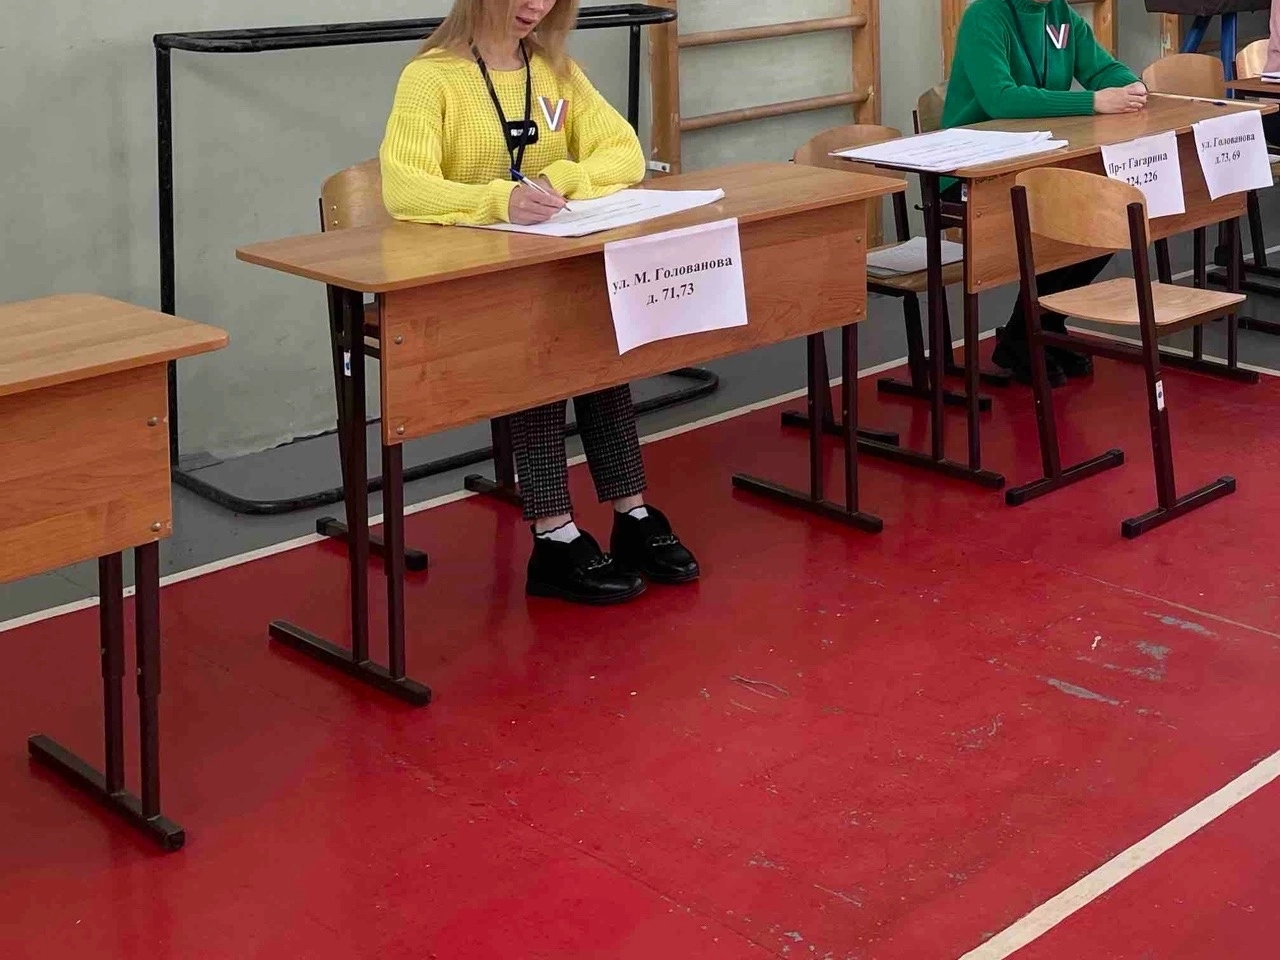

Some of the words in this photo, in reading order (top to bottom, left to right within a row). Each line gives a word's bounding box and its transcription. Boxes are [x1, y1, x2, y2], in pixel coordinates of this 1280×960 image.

[1201, 141, 1212, 152] ул.
[1213, 134, 1255, 147] Голованова
[1108, 162, 1126, 176] Пр-т
[1129, 152, 1168, 168] Гагарина
[1232, 149, 1241, 160] 69
[1144, 170, 1158, 183] 226
[612, 279, 630, 295] ул.
[633, 271, 651, 284] М.
[654, 257, 733, 282] Голованова
[646, 294, 658, 306] д.
[662, 283, 695, 301] 71,73
